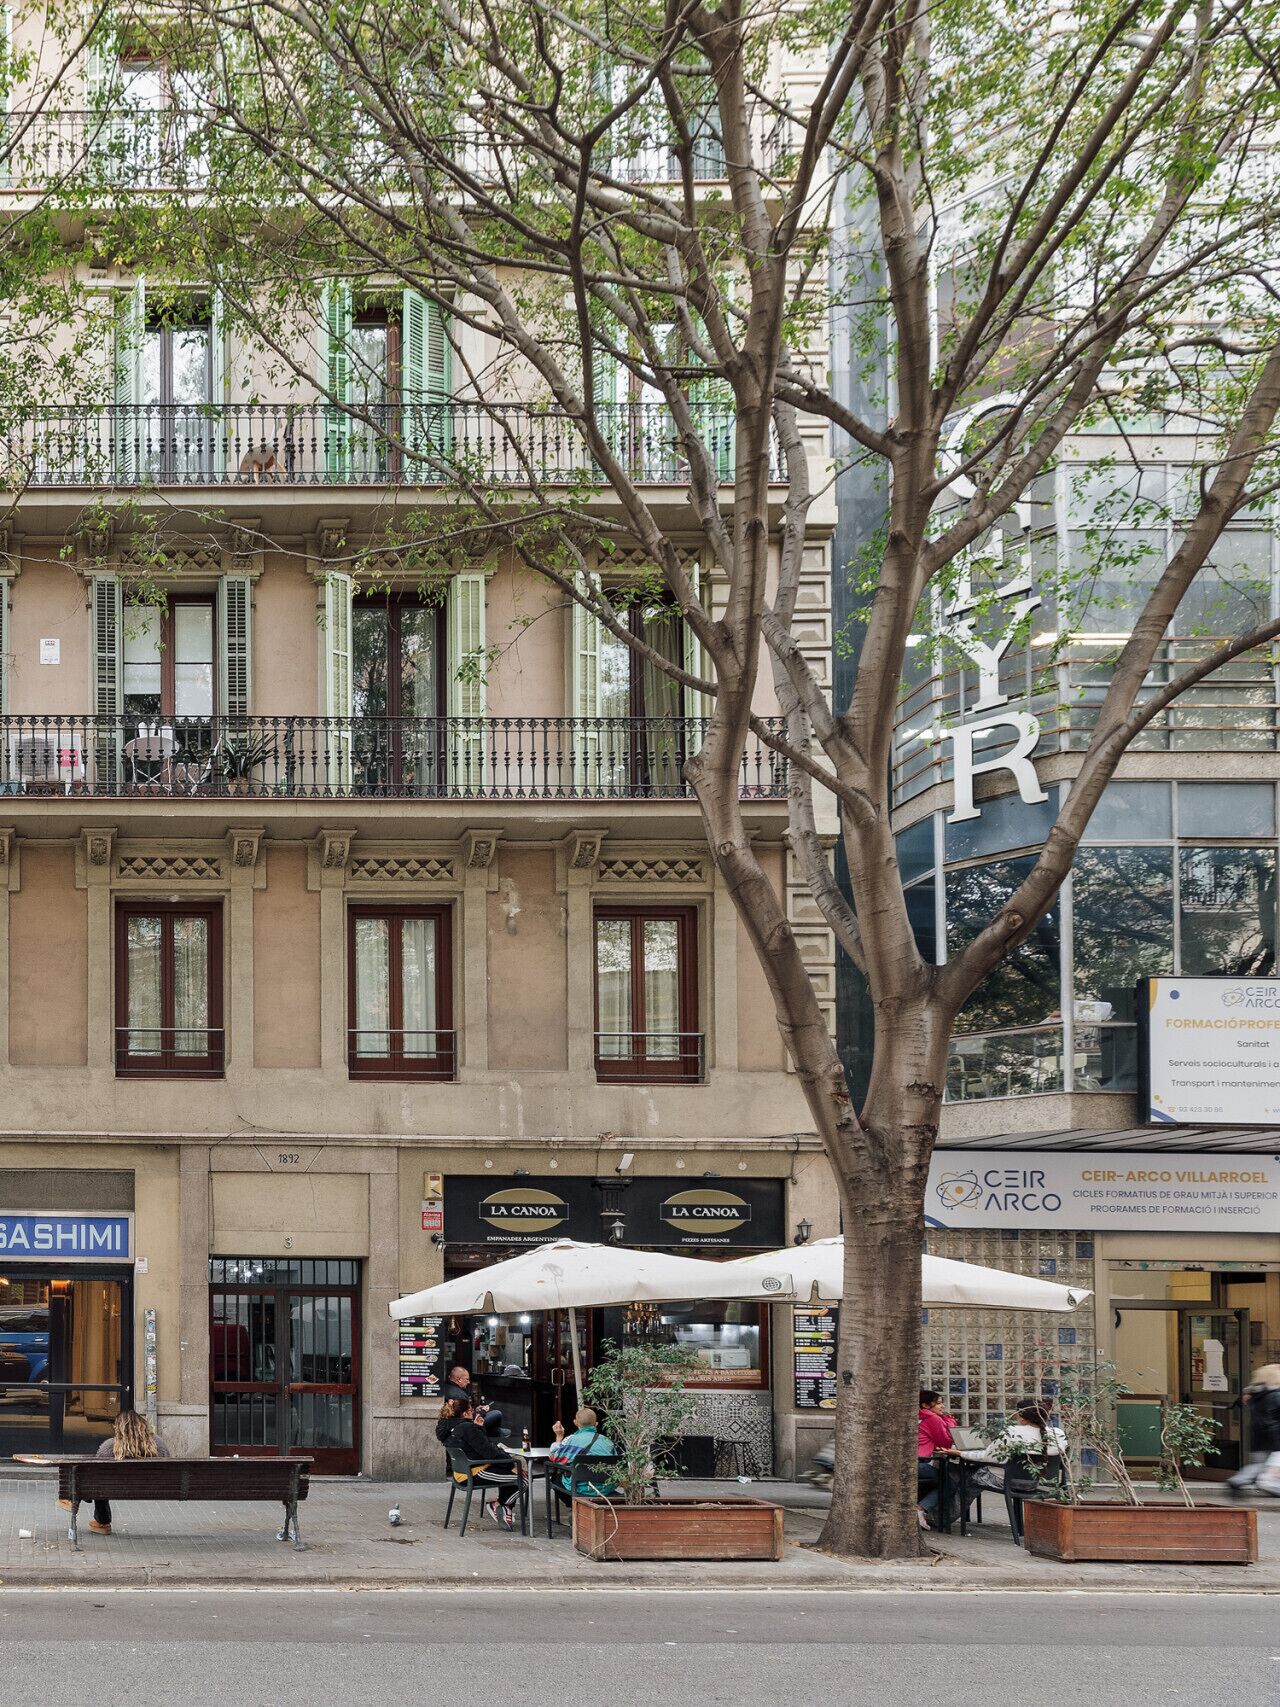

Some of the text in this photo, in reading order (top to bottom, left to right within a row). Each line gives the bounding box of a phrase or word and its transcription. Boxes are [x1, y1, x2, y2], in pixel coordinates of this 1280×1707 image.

[1245, 987, 1277, 997] CEIR
[1166, 1017, 1238, 1029] FORMACIÓ
[1236, 1040, 1270, 1048] Sanitat
[1168, 1059, 1201, 1067] Serveis
[1202, 1060, 1266, 1068] socioculturals
[1171, 1079, 1216, 1088] Transport
[278, 1153, 300, 1164] 1892
[984, 1169, 1045, 1188] CEIR
[1081, 1170, 1269, 1183] CEIR-ARCO VILLARROEL
[1072, 1190, 1104, 1198] CICLES
[1106, 1190, 1158, 1199] FORMATIUS
[1159, 1191, 1171, 1199] DE
[1173, 1191, 1199, 1199] GRAU
[1201, 1189, 1228, 1200] MITJÀ
[1234, 1192, 1278, 1200] SUPERIOR
[984, 1193, 1062, 1211] ARCO
[490, 1206, 558, 1216] LA CANOA
[672, 1207, 740, 1217] LA CANOA
[1090, 1204, 1147, 1213] PROGRAMES
[1148, 1205, 1160, 1213] DE
[1162, 1204, 1212, 1214] FORMACIÓ
[1217, 1205, 1261, 1215] INSERCIÓ
[283, 1237, 293, 1249] 3
